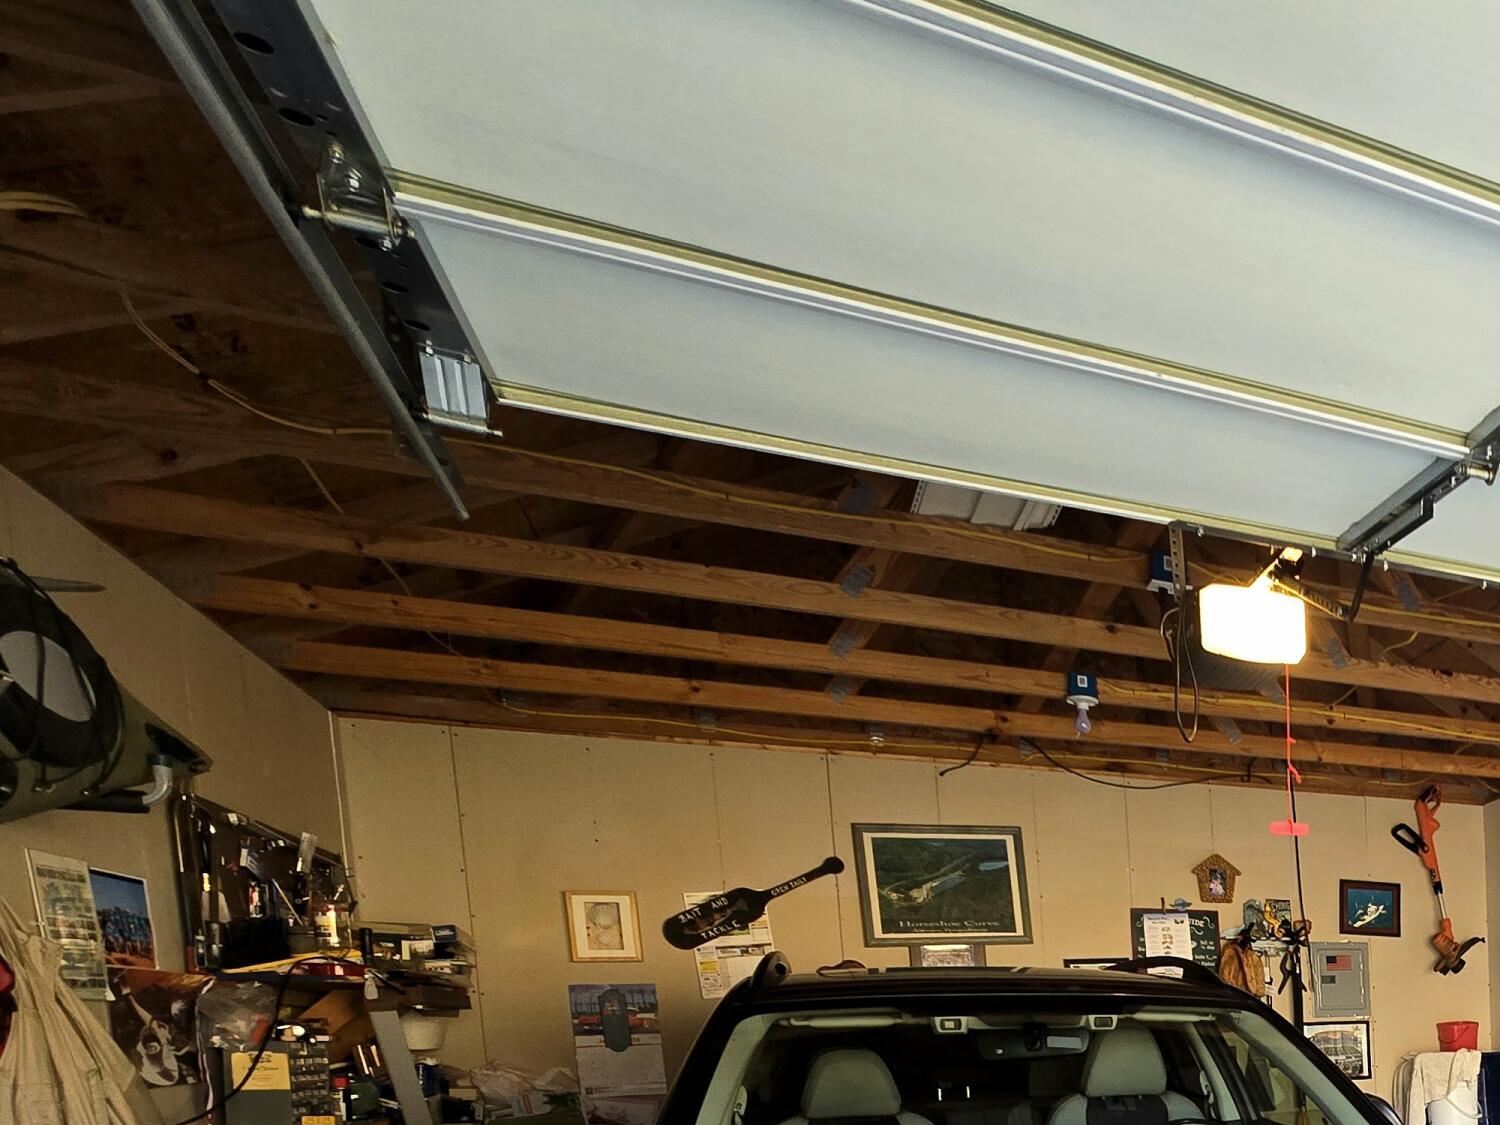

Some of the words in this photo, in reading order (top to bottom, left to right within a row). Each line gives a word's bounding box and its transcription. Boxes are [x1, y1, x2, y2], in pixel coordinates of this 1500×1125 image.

[770, 885, 790, 896] OPEN
[789, 876, 808, 889] DAILY
[678, 908, 702, 924] BAIT
[711, 896, 729, 910] AND
[700, 919, 742, 940] TACKLE
[899, 919, 962, 928] Horseshoe
[964, 919, 1000, 928] Curve
